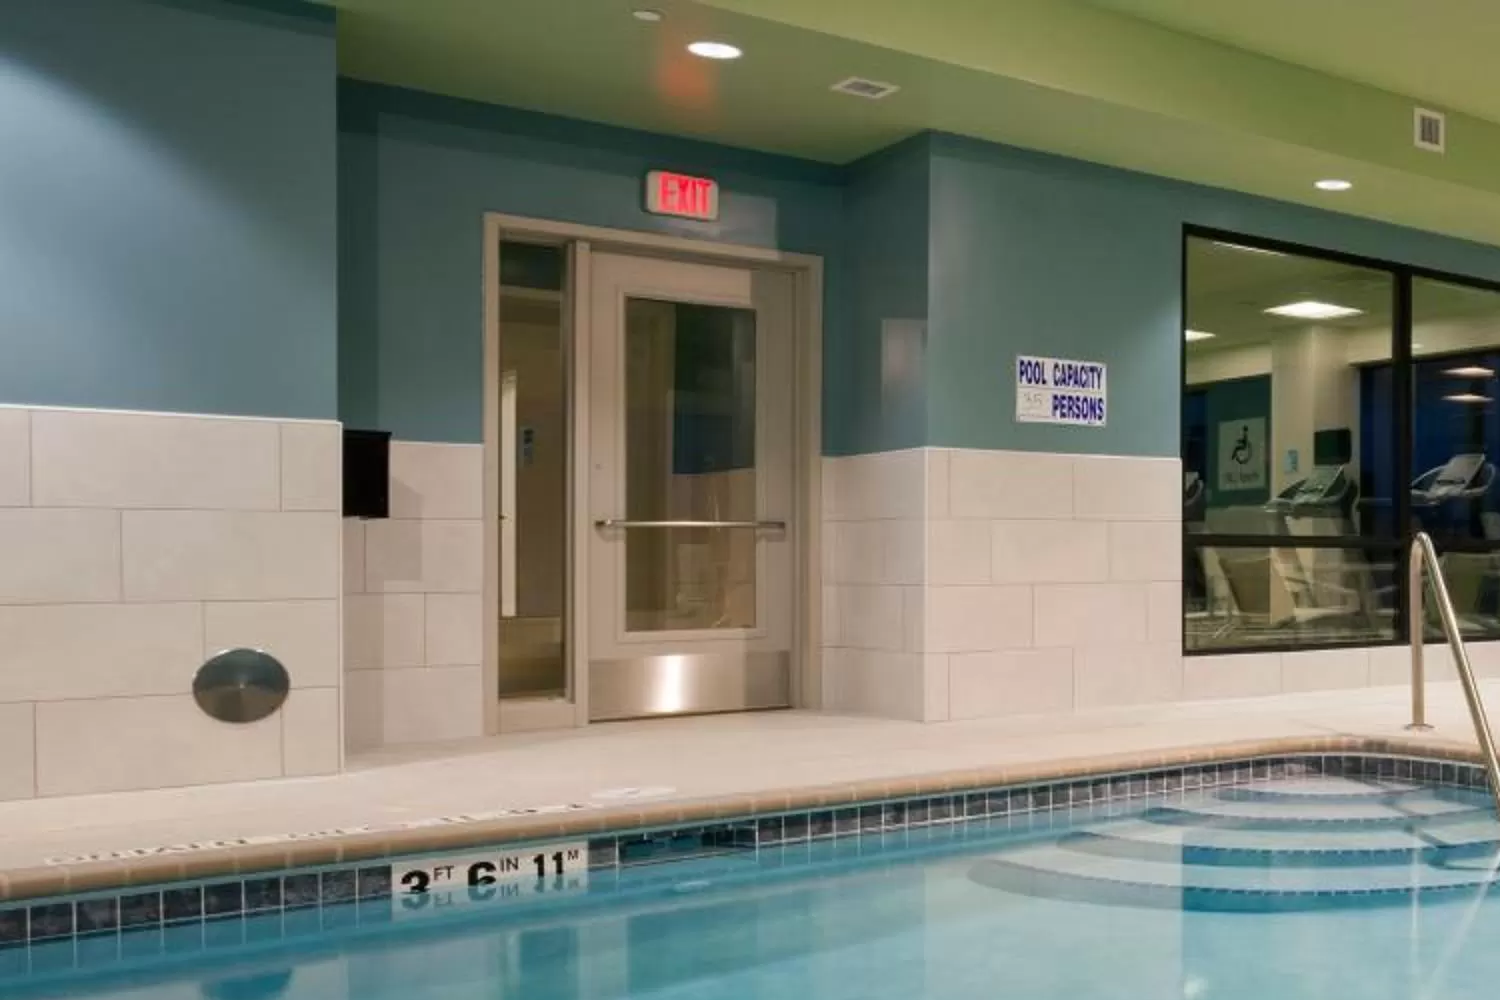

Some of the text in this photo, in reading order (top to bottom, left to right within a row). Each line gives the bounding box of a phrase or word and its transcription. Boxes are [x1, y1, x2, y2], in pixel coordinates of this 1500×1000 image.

[660, 172, 712, 216] EXIT
[1019, 359, 1103, 389] POOL CAPACITY
[1052, 393, 1104, 420] PERSONS
[433, 864, 454, 881] FT
[500, 856, 519, 873] IN
[567, 850, 579, 861] M
